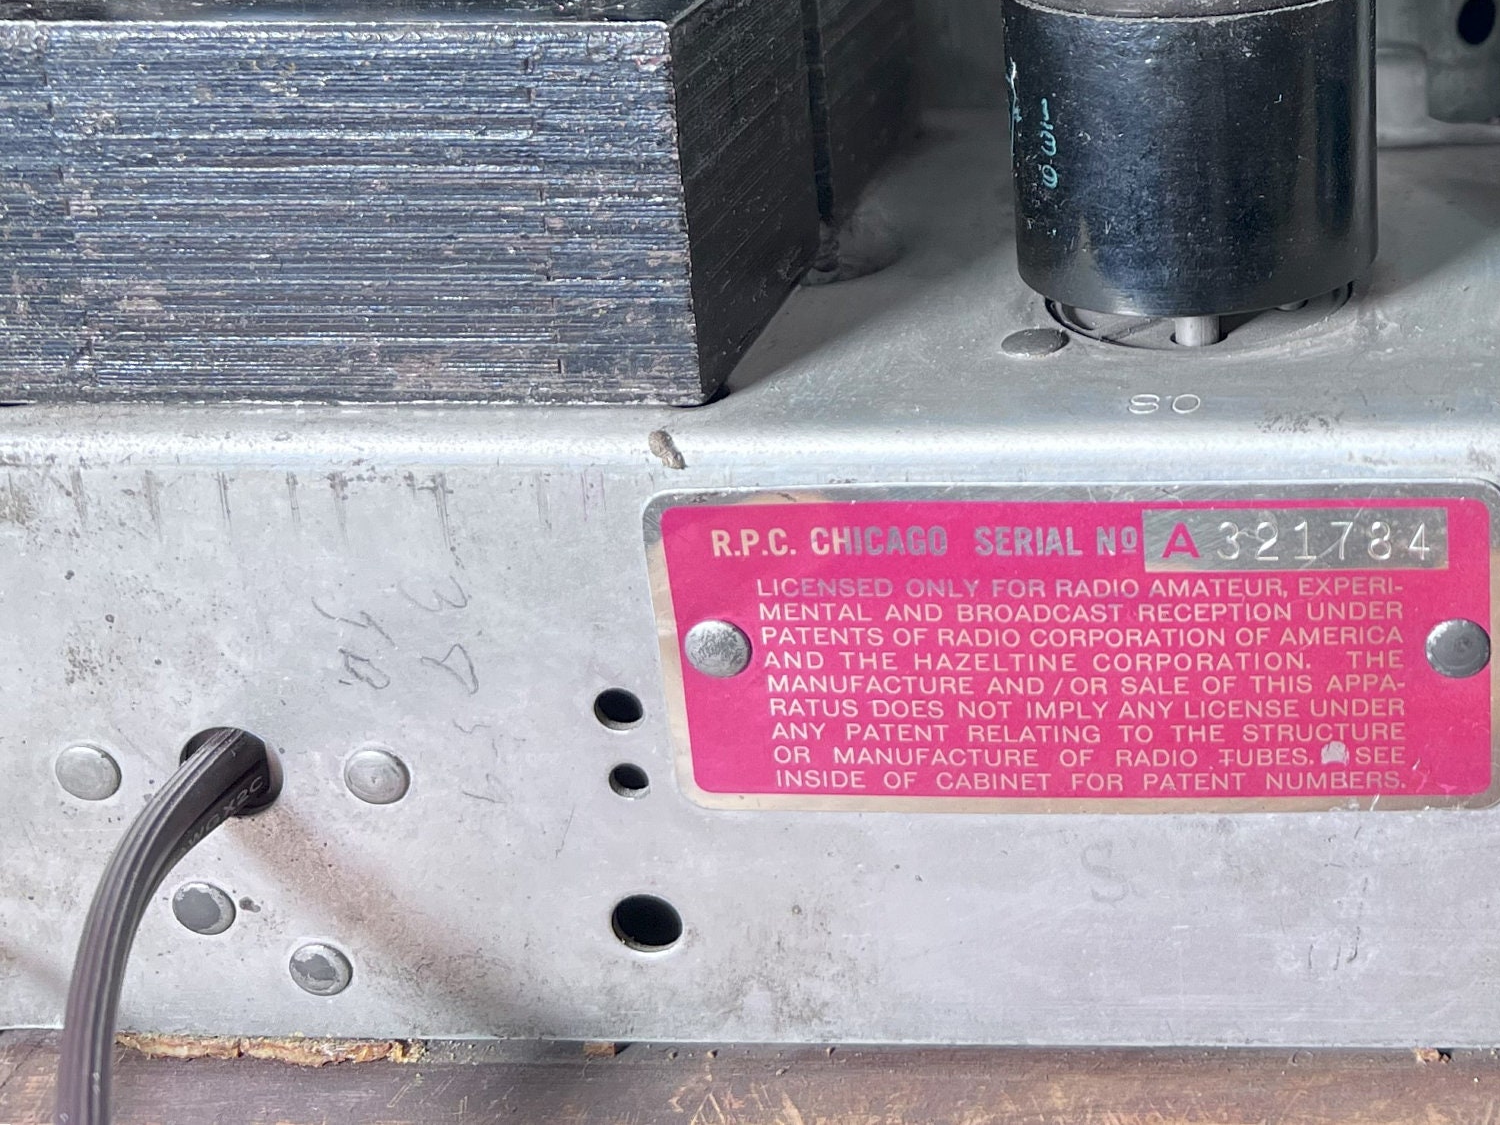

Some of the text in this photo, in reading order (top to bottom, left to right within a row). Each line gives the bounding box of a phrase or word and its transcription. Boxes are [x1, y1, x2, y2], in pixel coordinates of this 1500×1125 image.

[710, 527, 797, 558] R.P.C.
[809, 525, 948, 557] CHICAGO
[974, 526, 1084, 557] SERIAL
[1161, 521, 1201, 559] A
[1215, 520, 1431, 562] 321784
[756, 576, 1403, 599] LICENSED ONLY FOR RADIO AMATEUR, EXPERI-
[757, 601, 1403, 624] MENTAL AND BROADCAST RECEPTION UNDER
[759, 625, 1404, 649] PATENTS OF RADIO CORPORATION OF AMERICA
[762, 649, 1404, 674] AND THE HAZELTINE CORPORATION. THE
[764, 673, 975, 696] MANUFACTURE
[1120, 675, 1190, 697] SALE
[1201, 675, 1238, 696] OF
[1249, 674, 1313, 694] THIS
[1326, 673, 1406, 693] APPA-
[767, 697, 1405, 720] RATUS DOES NOT IMPLY ANY LICENSE UNDER
[770, 721, 1405, 744] ANY PATENT RELATING TO THE STRUCTURE
[772, 744, 812, 766] OR
[831, 745, 1039, 768] MANUFACTURE
[1058, 748, 1094, 769] OF
[1115, 748, 1198, 769] RADIO
[1355, 746, 1405, 765] SEE
[774, 768, 1406, 792] INSIDE OF CABINET FOR PATENT NUMBERS.
